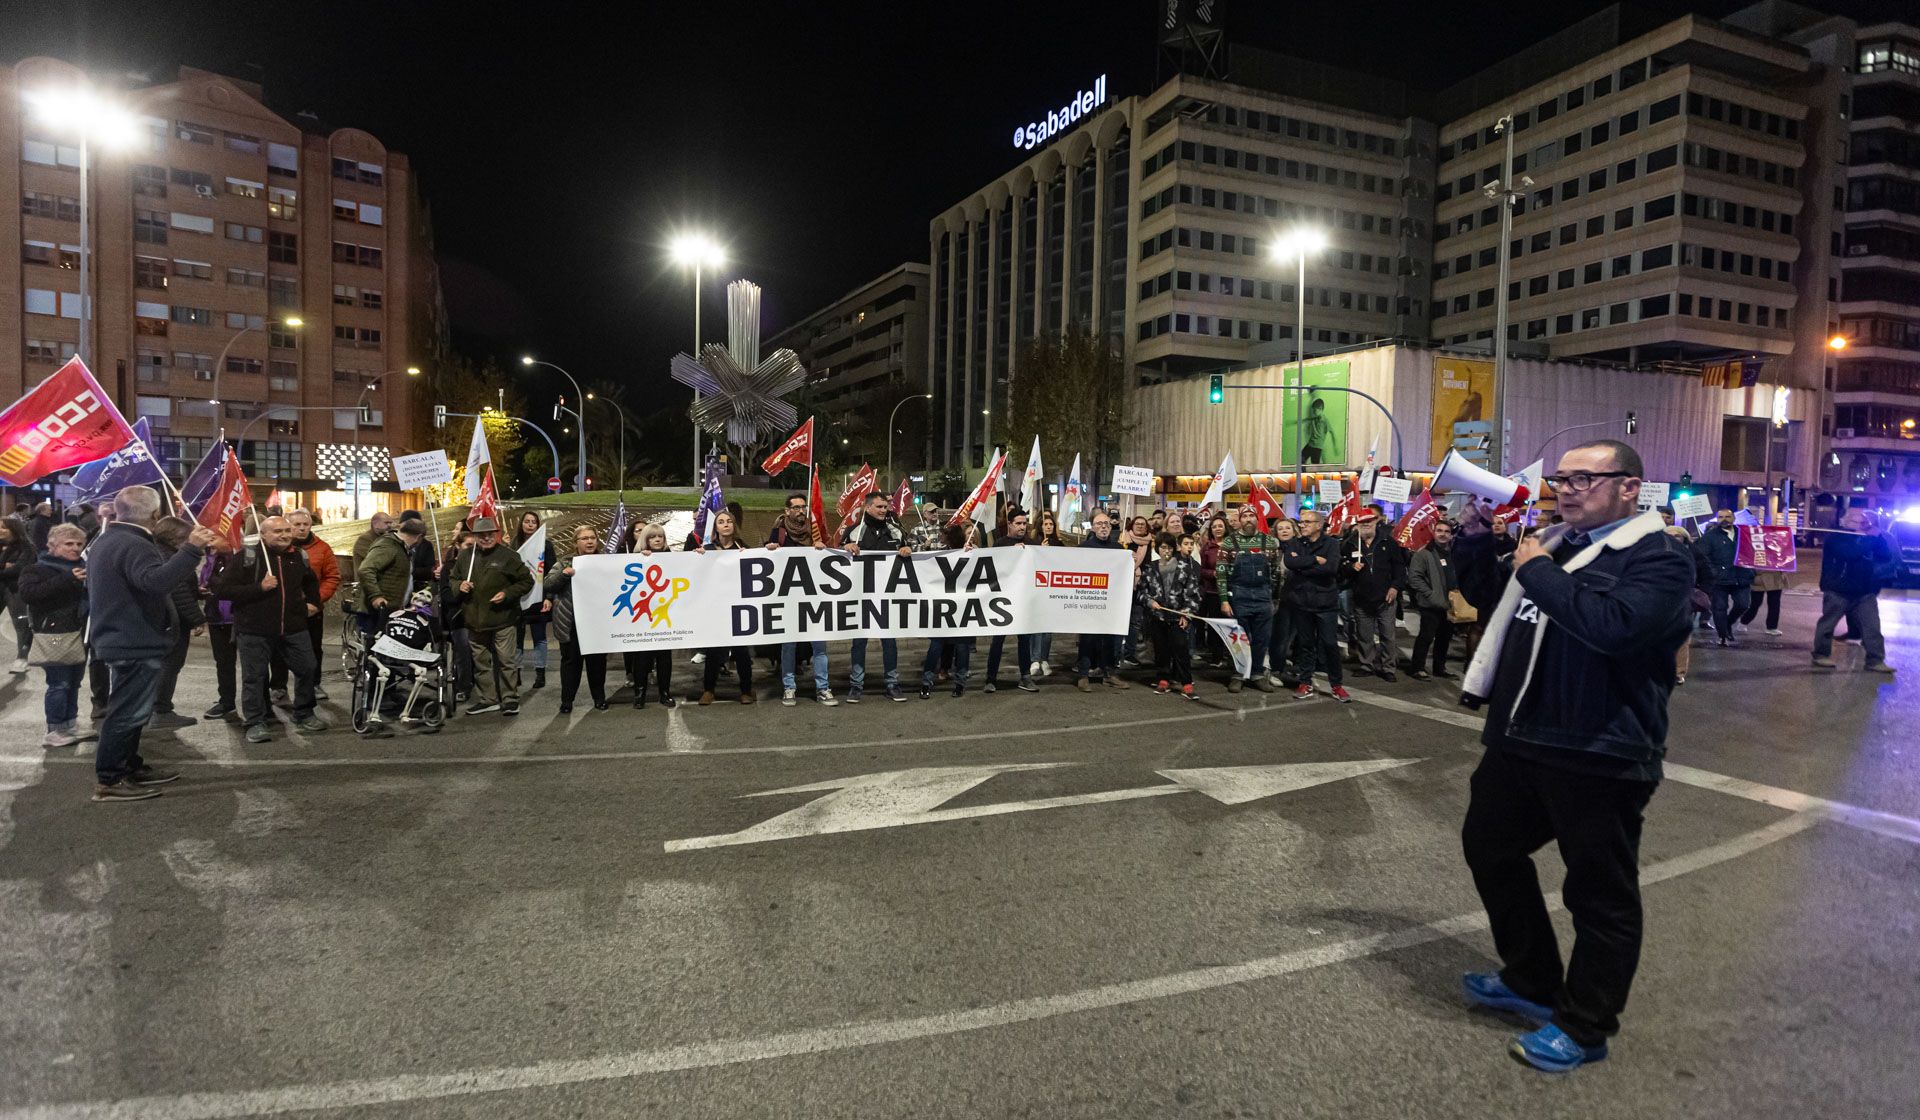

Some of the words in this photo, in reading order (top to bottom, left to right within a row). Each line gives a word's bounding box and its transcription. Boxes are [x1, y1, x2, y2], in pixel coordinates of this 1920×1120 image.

[1024, 73, 1106, 150] Sabadell
[1118, 469, 1149, 478] BARCALA
[739, 555, 922, 599] BASTA
[934, 556, 1002, 594] YA
[1053, 575, 1091, 586] CCOO
[1063, 602, 1078, 610] país
[1079, 602, 1107, 610] valencià
[731, 603, 785, 637] DE
[799, 597, 1014, 633] MENTIRAS
[390, 626, 414, 639] ¡YA!
[644, 630, 672, 638] Empleados
